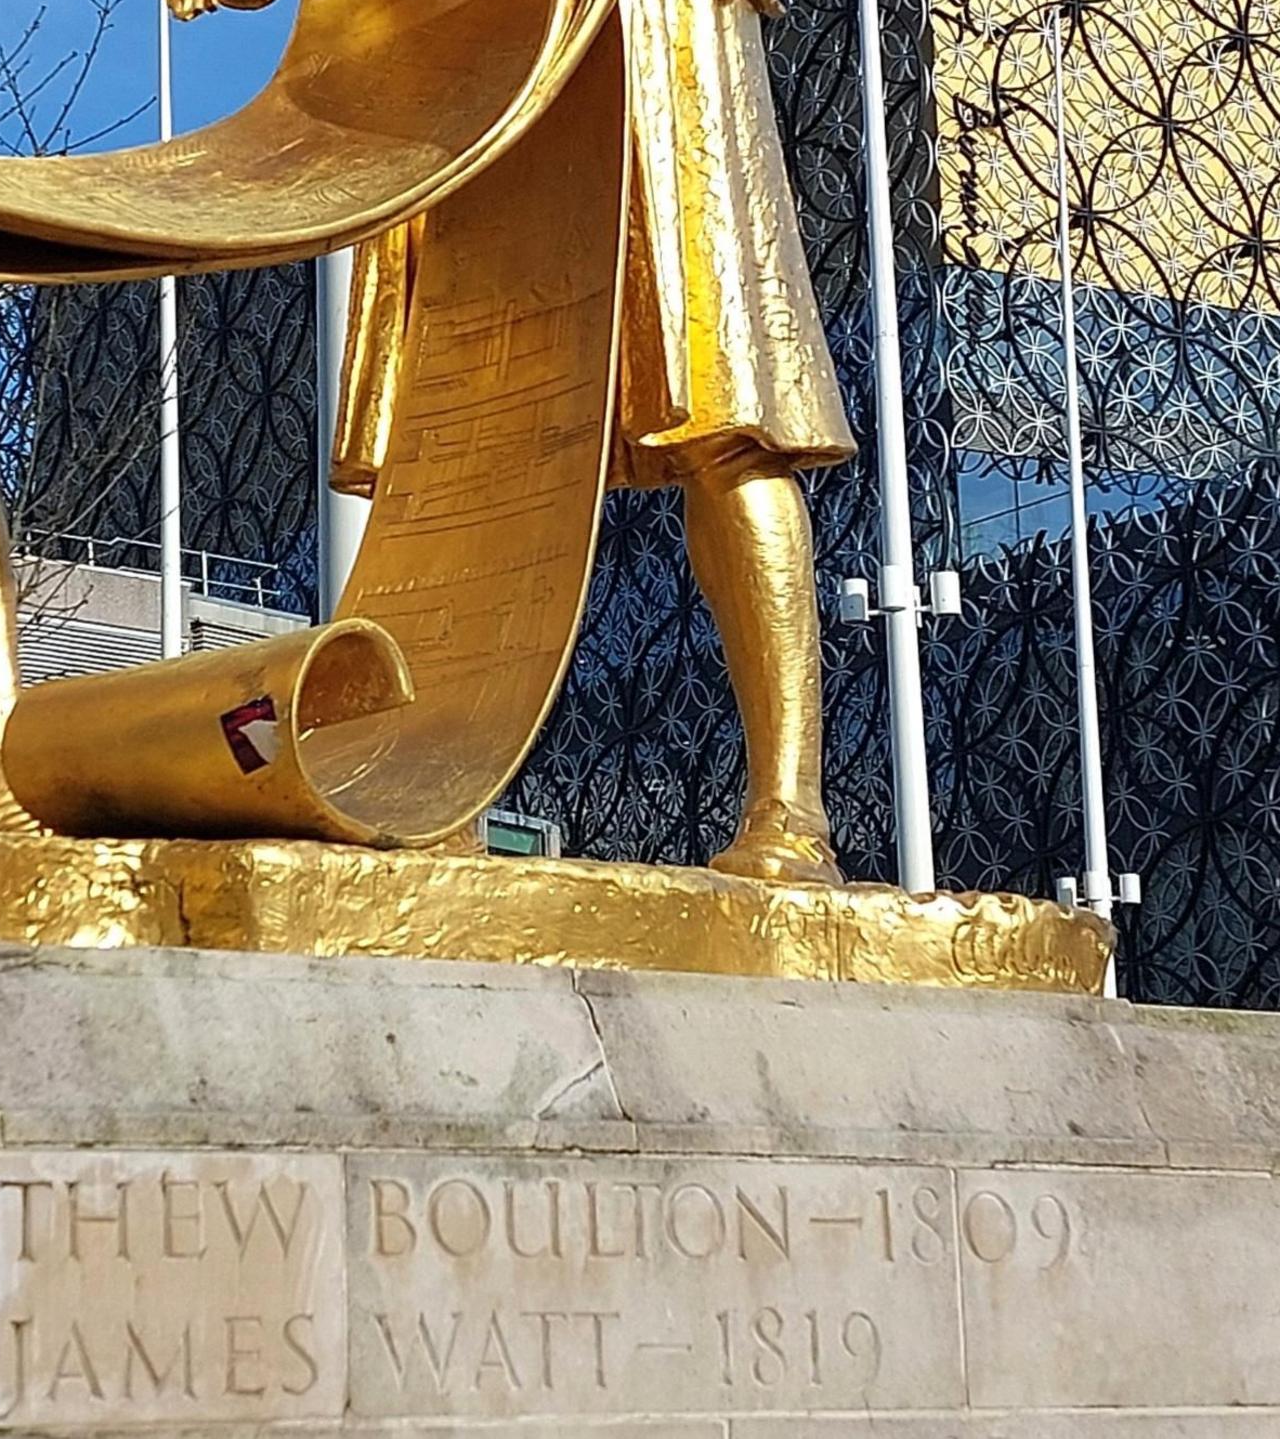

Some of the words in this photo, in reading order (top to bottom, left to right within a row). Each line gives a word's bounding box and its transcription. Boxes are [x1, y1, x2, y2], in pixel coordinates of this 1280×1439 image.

[369, 1176, 791, 1261] BOULTON
[875, 1186, 1071, 1271] 1809
[372, 1309, 621, 1396] WATT
[714, 1305, 883, 1392] 1819
